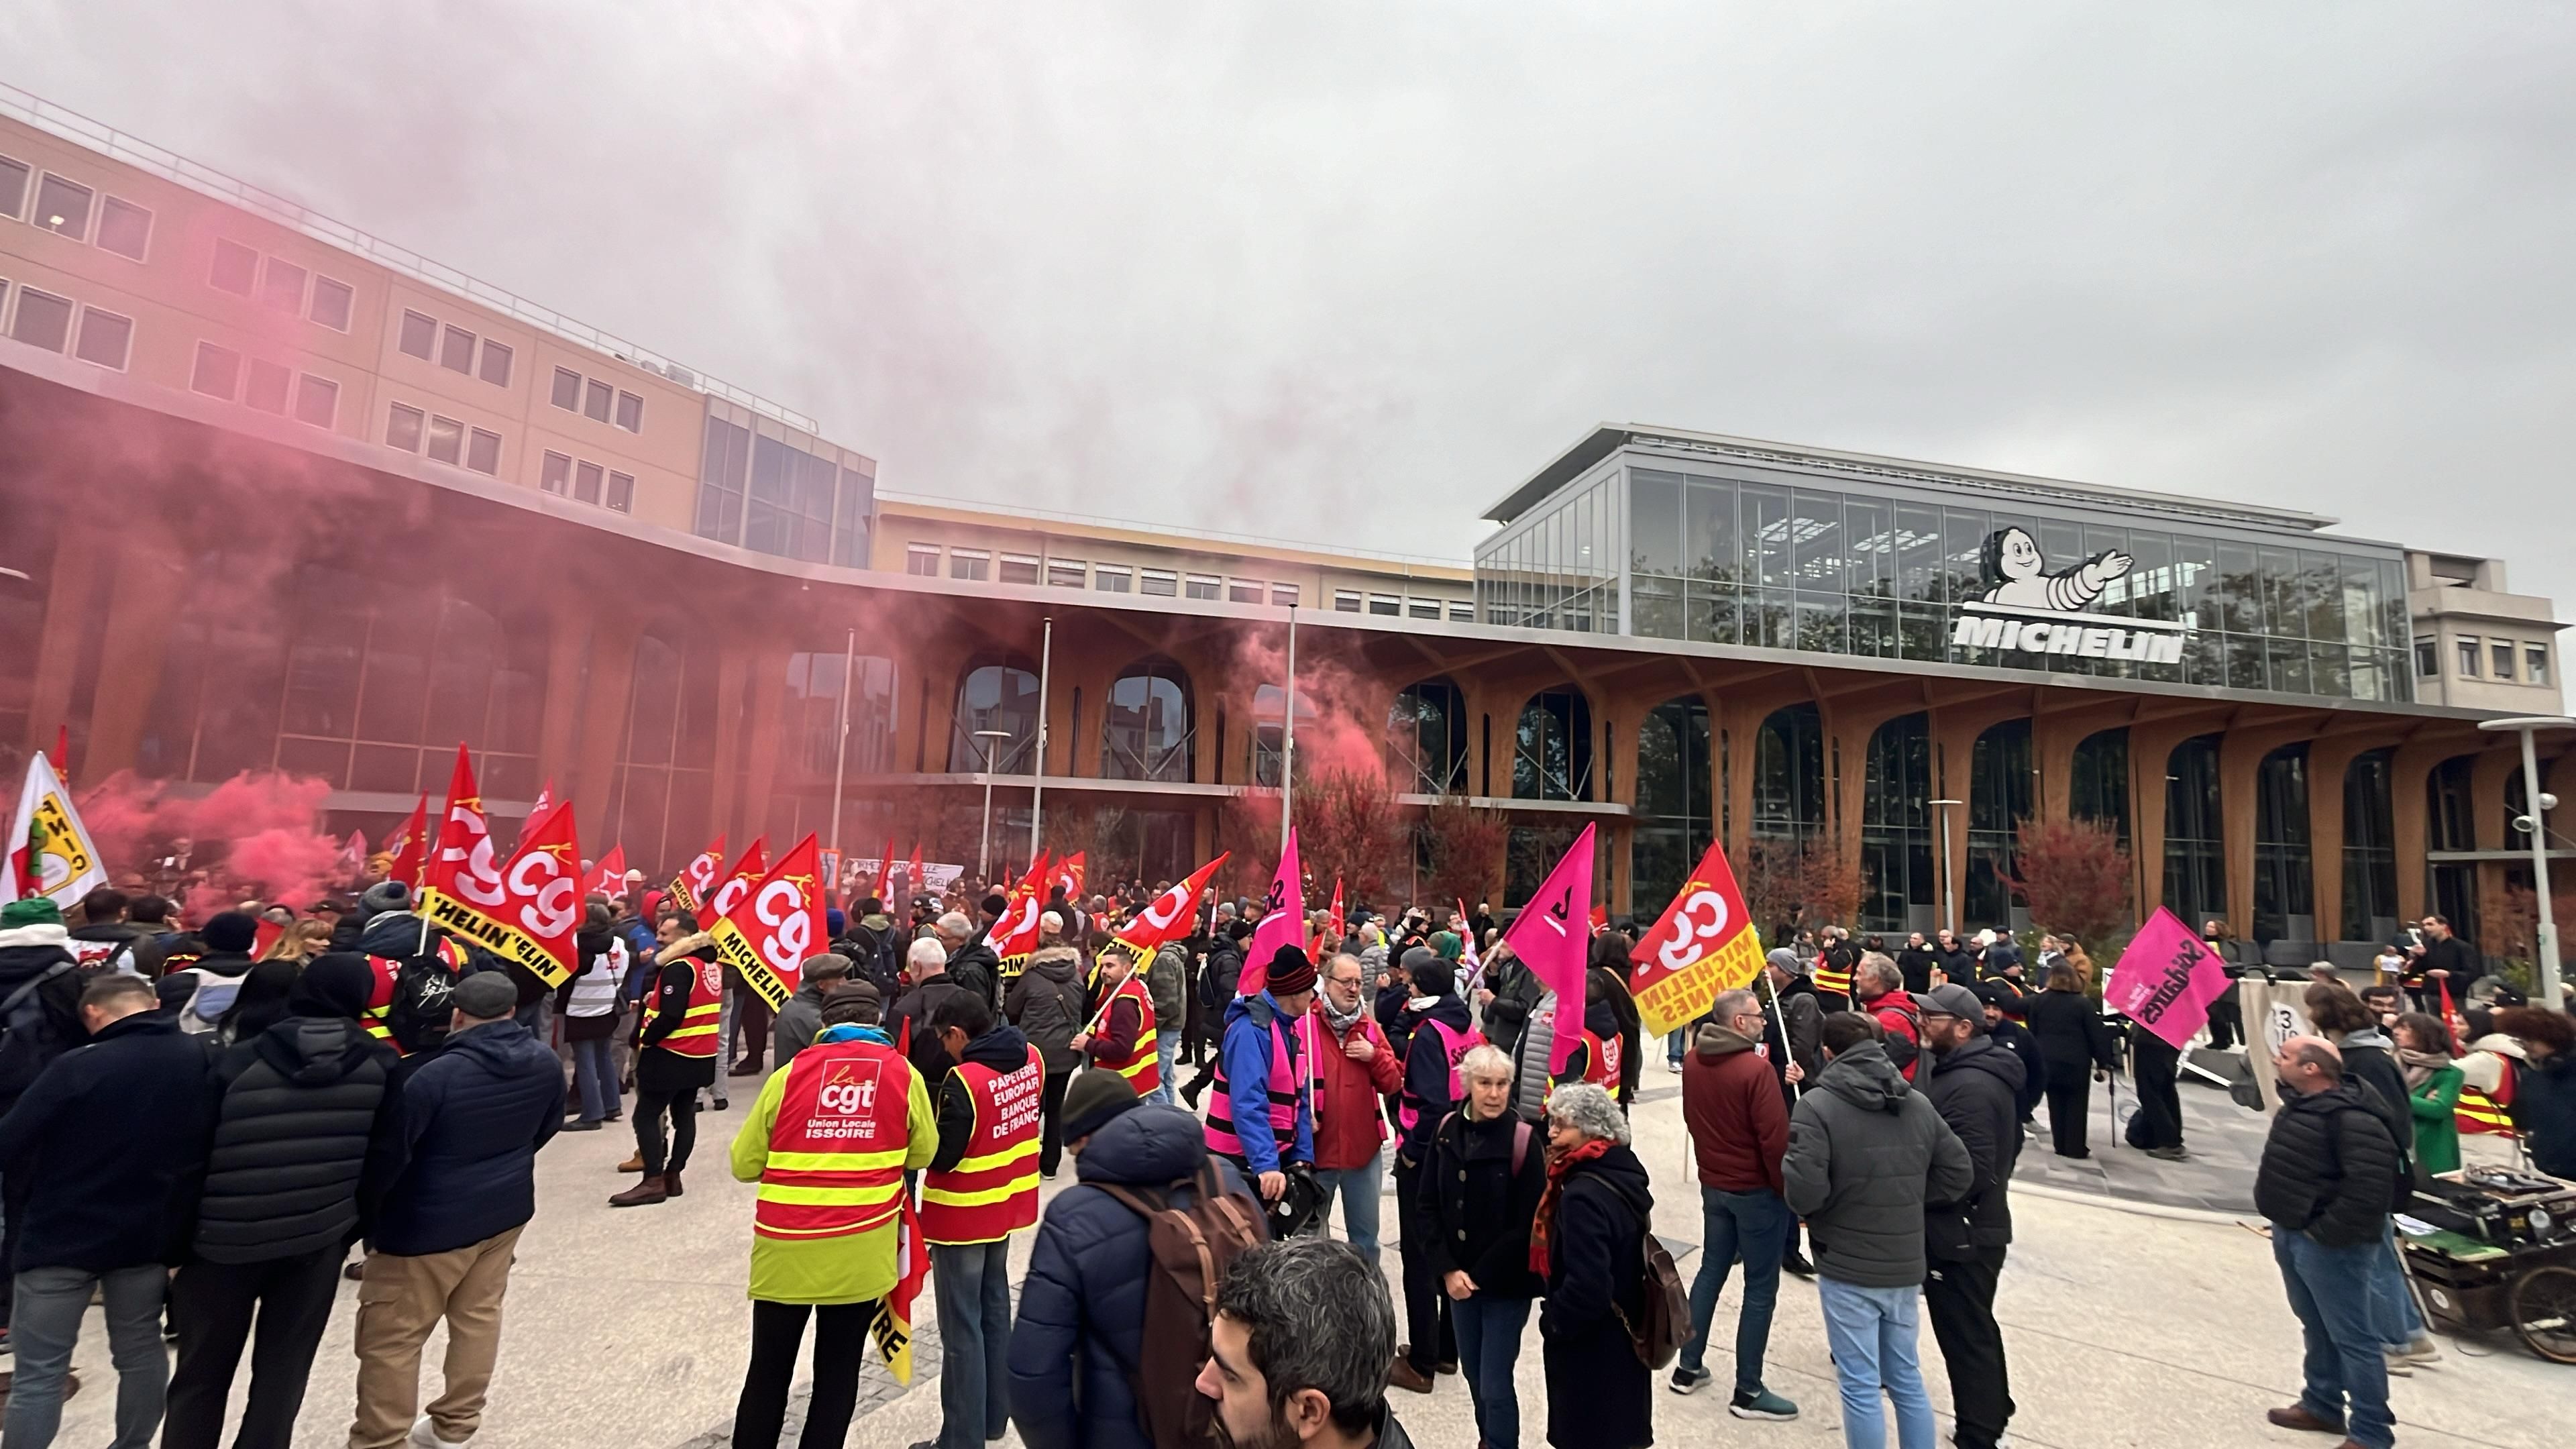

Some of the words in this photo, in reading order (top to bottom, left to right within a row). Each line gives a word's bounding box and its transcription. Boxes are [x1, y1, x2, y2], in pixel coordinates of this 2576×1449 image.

[1953, 616, 2184, 663] MICHELIN
[508, 851, 576, 938] cg
[435, 896, 509, 950] HELIN
[755, 880, 810, 971] cg
[515, 934, 557, 977] ELIN
[723, 932, 790, 1008] MICHELIN
[826, 1065, 868, 1085] la
[987, 1062, 1038, 1093] PAPETERIE
[820, 1079, 875, 1115] cgt
[1001, 1093, 1038, 1121] BANQUE
[806, 1128, 875, 1139] ISSOIRE
[807, 1119, 839, 1128] Union
[842, 1118, 876, 1128] Locale
[993, 1122, 1009, 1139] DE
[1009, 1108, 1040, 1133] FRANC
